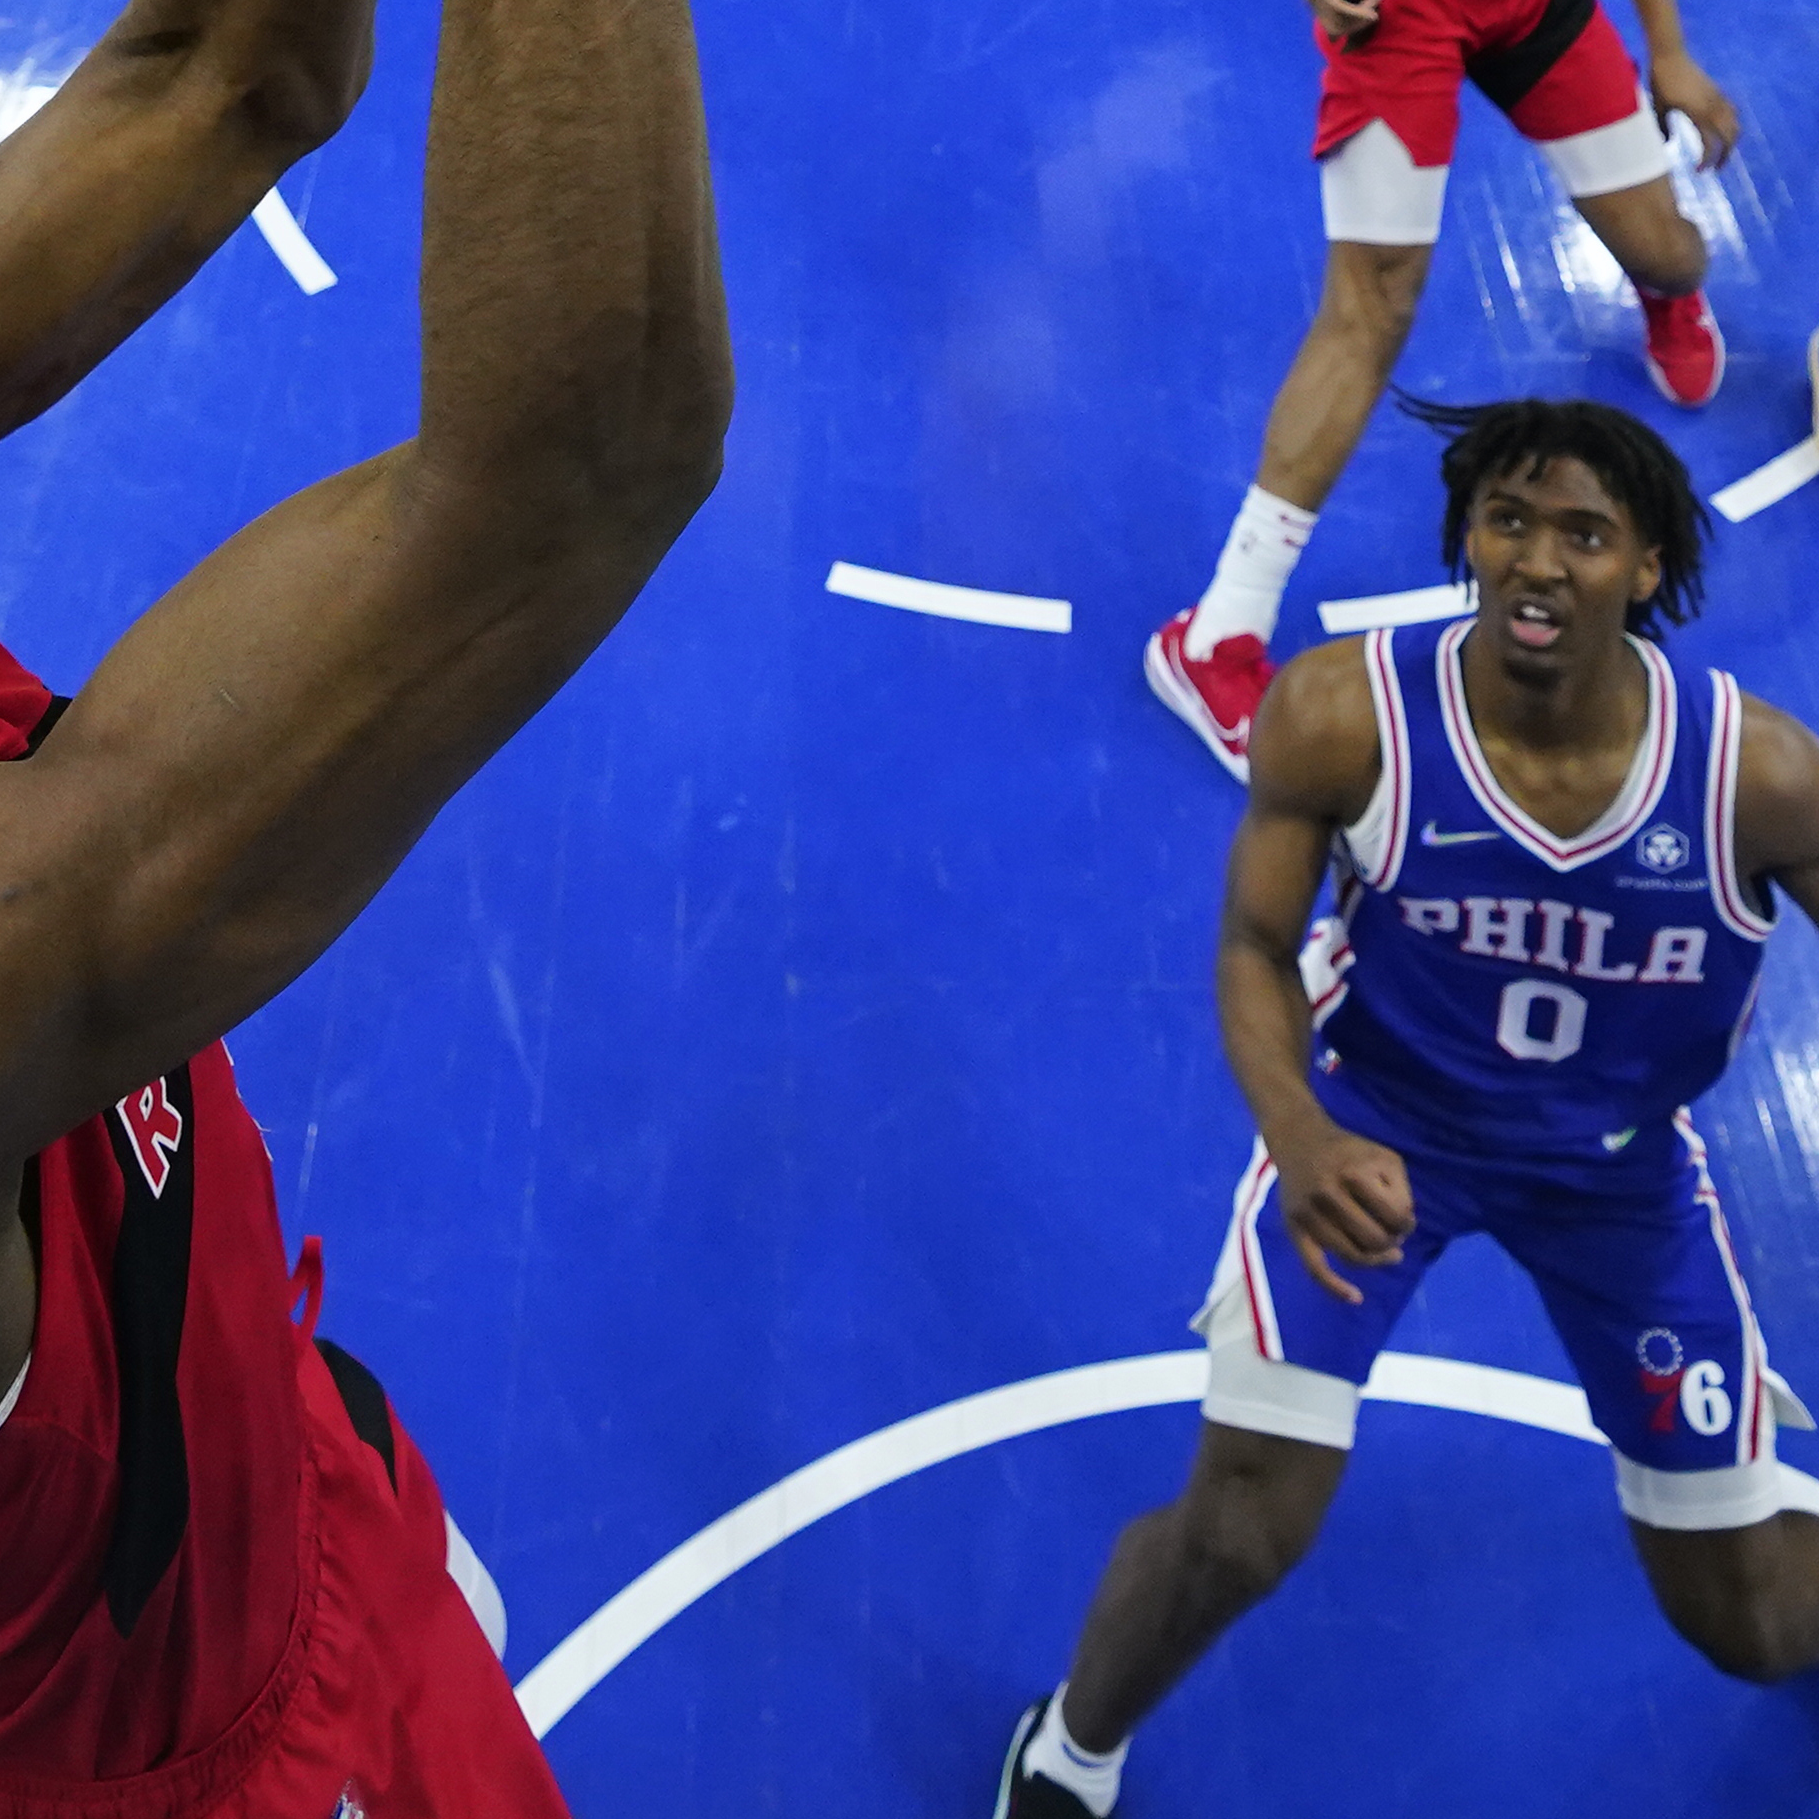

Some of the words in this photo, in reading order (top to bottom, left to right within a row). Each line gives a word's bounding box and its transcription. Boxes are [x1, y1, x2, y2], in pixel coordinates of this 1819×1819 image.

[1397, 894, 1709, 984] PHILA
[1495, 978, 1589, 1064] 0
[1639, 1359, 1733, 1437] 76
